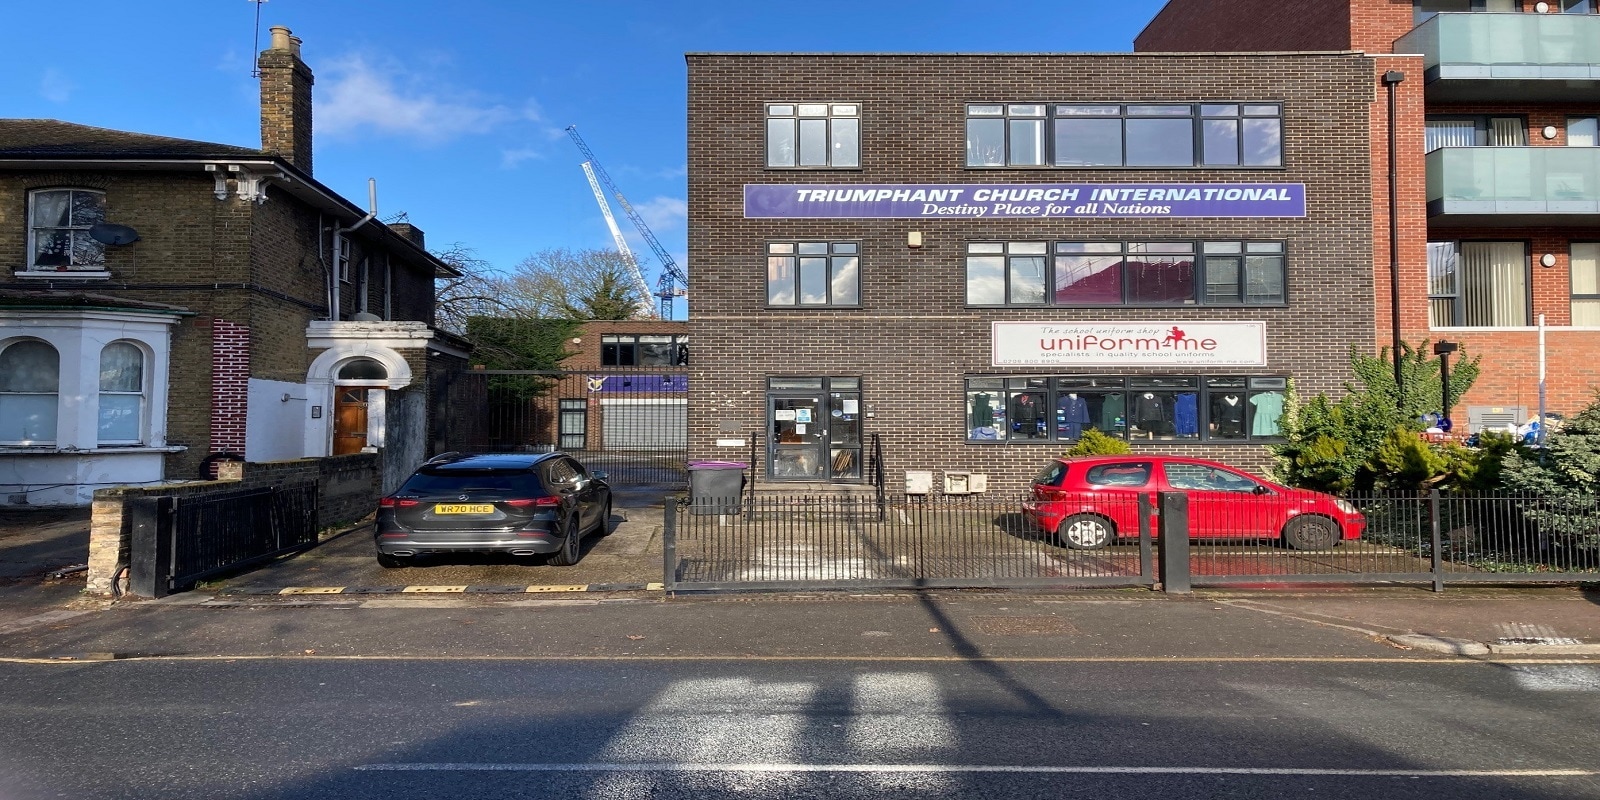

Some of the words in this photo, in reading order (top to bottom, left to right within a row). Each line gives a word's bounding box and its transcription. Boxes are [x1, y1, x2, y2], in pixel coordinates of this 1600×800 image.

[797, 189, 964, 202] TRIUMPHANT
[973, 188, 1080, 202] CHURCH
[1090, 188, 1292, 201] INTERNATIONAL
[921, 203, 988, 217] Destiny
[992, 203, 1041, 215] Place
[1042, 203, 1071, 217] for
[1074, 203, 1098, 214] all
[1102, 203, 1171, 214] Nations
[1096, 327, 1134, 336] uniform
[1137, 327, 1160, 335] shop
[441, 505, 467, 513] WR70
[469, 505, 489, 513] HCE
